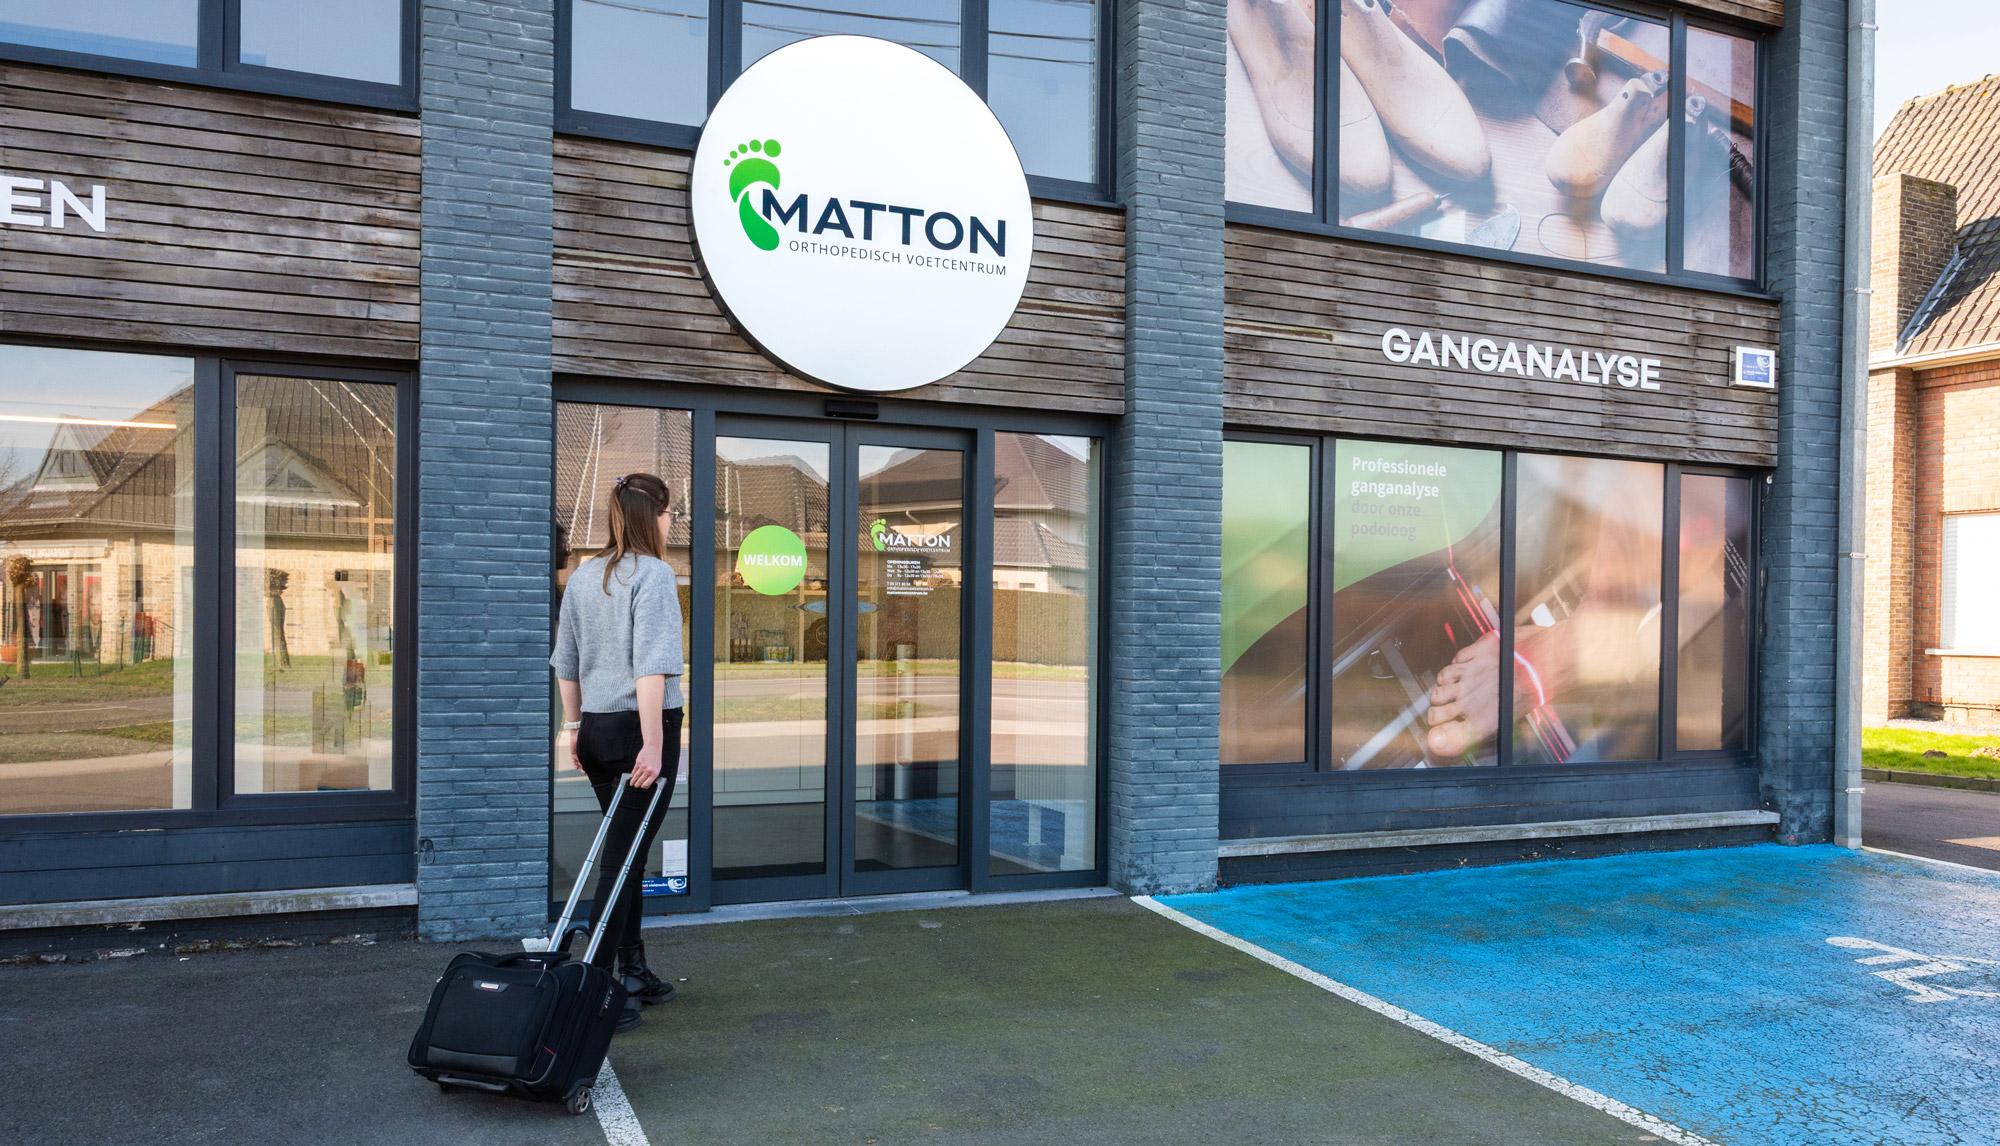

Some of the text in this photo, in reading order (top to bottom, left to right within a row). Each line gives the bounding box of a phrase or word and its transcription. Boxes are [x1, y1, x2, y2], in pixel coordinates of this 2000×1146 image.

[762, 188, 1007, 258] MATTON
[788, 239, 1007, 276] ORTHOPEDISCH VOETCENTRUM
[1381, 327, 1662, 391] GANGANALYSE
[1352, 456, 1448, 477] Professionele
[1351, 480, 1440, 500] ganganalyse
[1351, 500, 1421, 517] door onze
[879, 532, 951, 548] MATTON
[1351, 522, 1417, 541] podoloog
[743, 553, 803, 568] WELKOM
